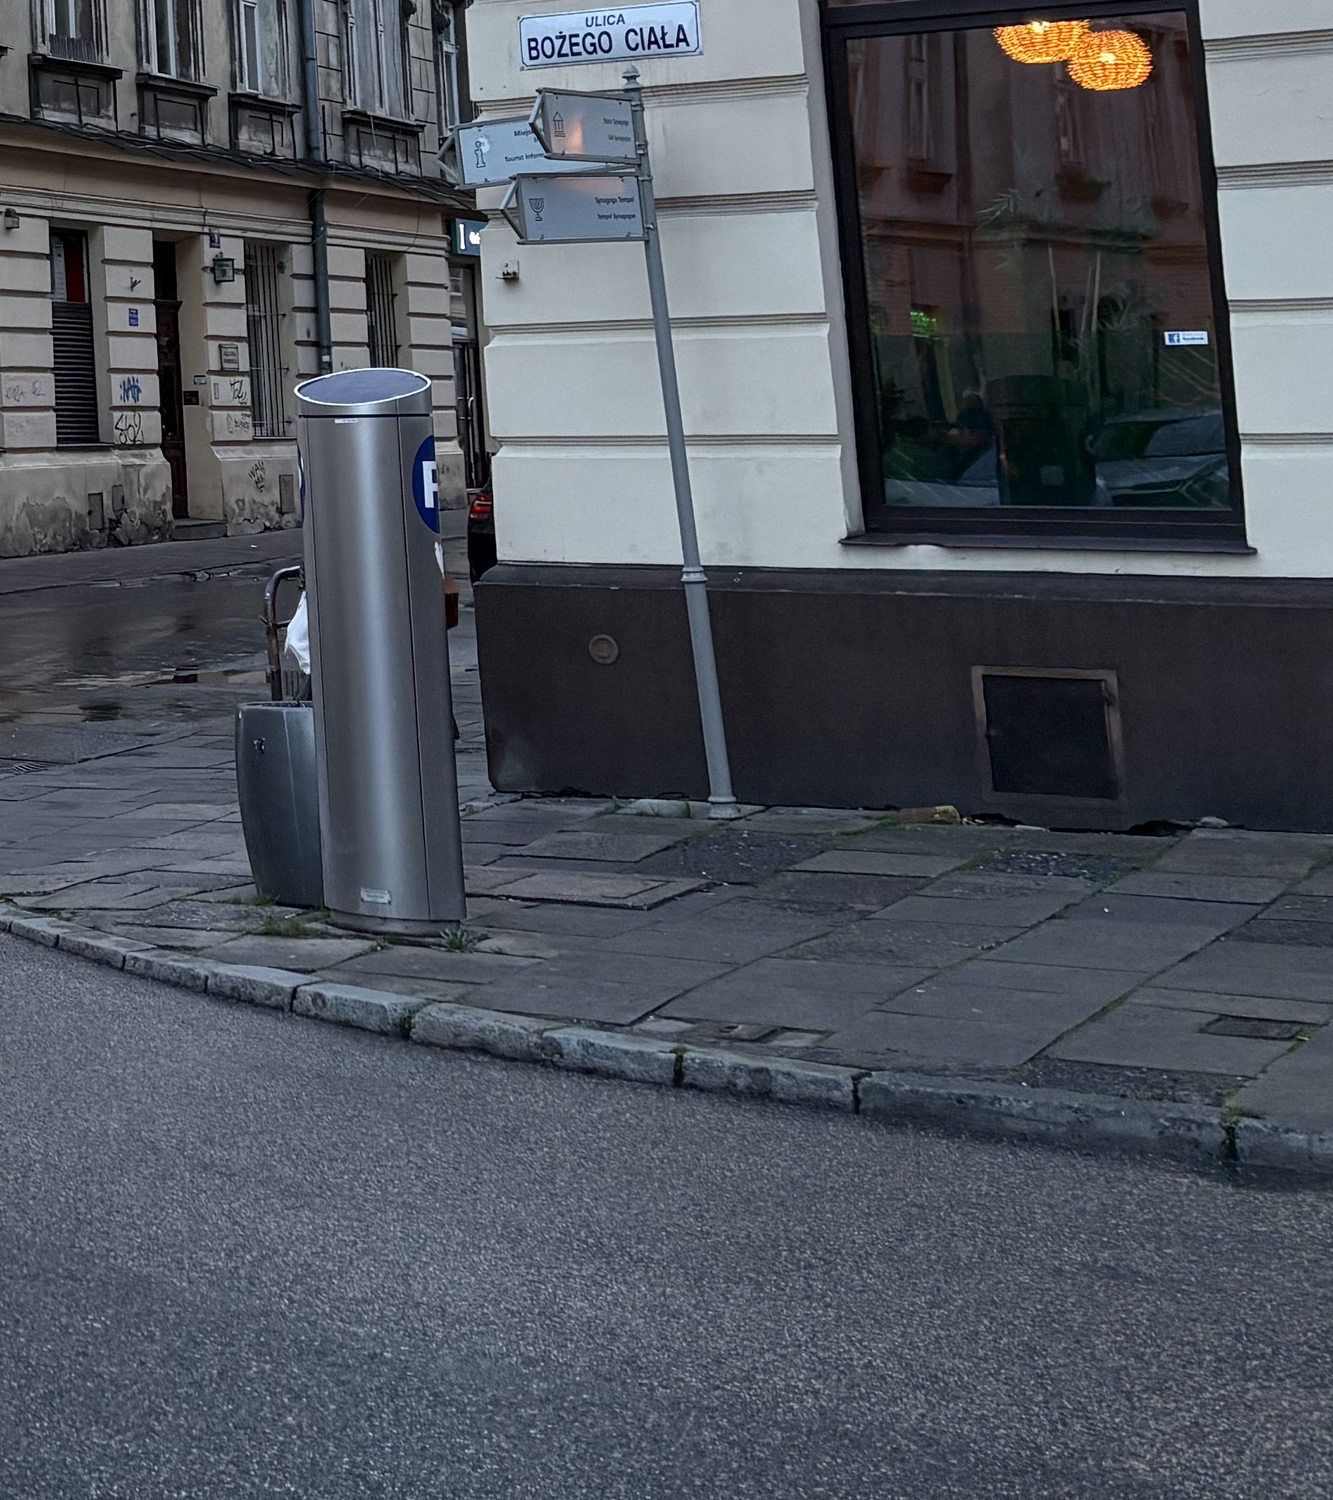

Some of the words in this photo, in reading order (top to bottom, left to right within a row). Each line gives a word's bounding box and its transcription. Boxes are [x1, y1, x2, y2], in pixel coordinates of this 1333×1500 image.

[585, 13, 626, 28] ULICA
[527, 31, 613, 61] BOŻEGO
[624, 23, 690, 52] CIAŁA
